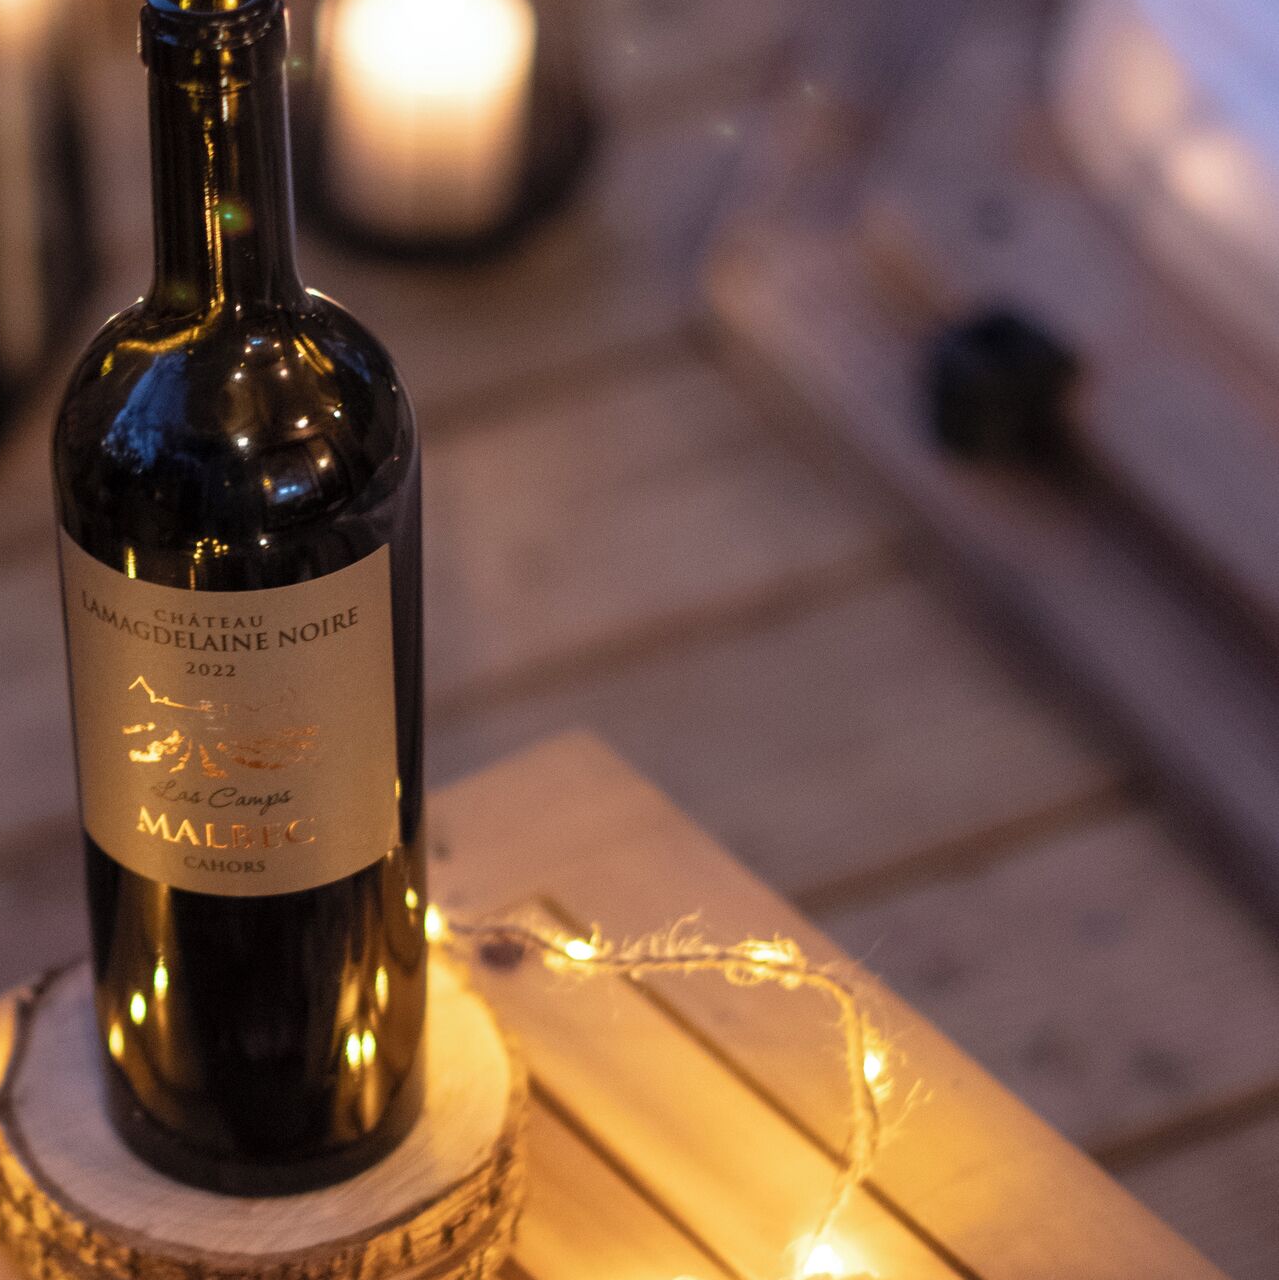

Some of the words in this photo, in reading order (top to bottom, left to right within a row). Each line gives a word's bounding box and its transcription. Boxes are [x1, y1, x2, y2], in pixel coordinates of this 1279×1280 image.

[82, 591, 269, 652] LAMAGDELAINE
[278, 606, 359, 649] NOIRE
[154, 609, 264, 629] CHÂTEAU
[185, 662, 236, 677] 2022
[208, 786, 294, 816] Camps
[136, 806, 316, 849] MALBEC
[184, 855, 266, 874] CAHORS
